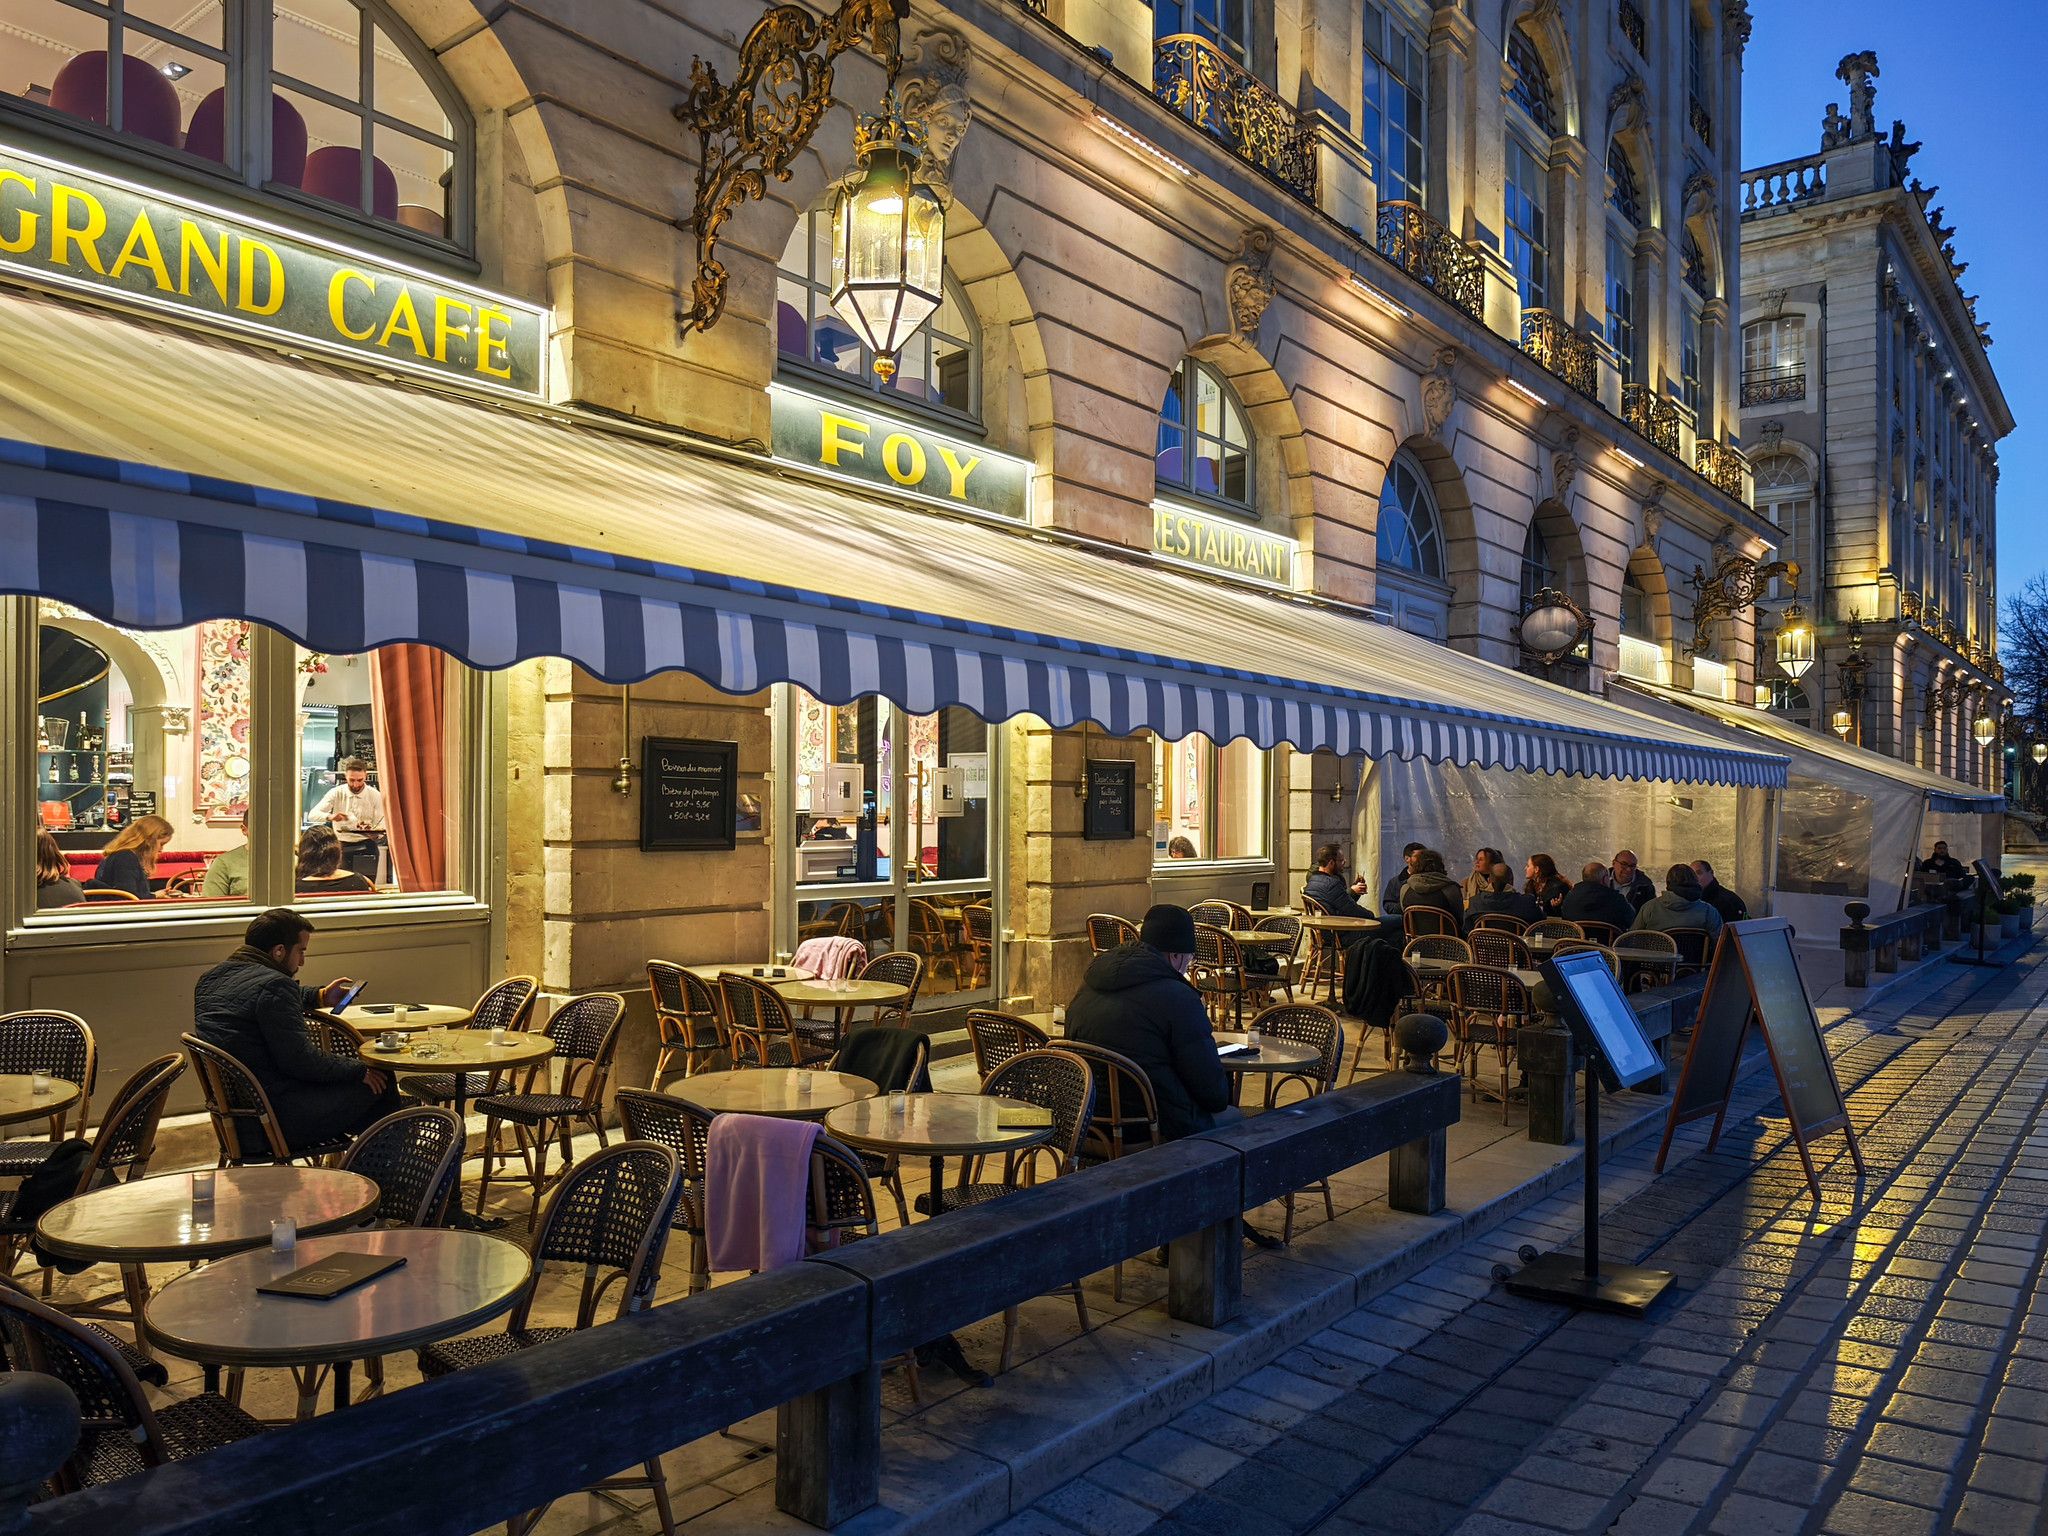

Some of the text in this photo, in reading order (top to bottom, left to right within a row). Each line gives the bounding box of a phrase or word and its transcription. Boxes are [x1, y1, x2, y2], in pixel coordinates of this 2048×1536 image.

[0, 169, 513, 380] GRAND CAFÉ
[818, 410, 983, 501] FOY
